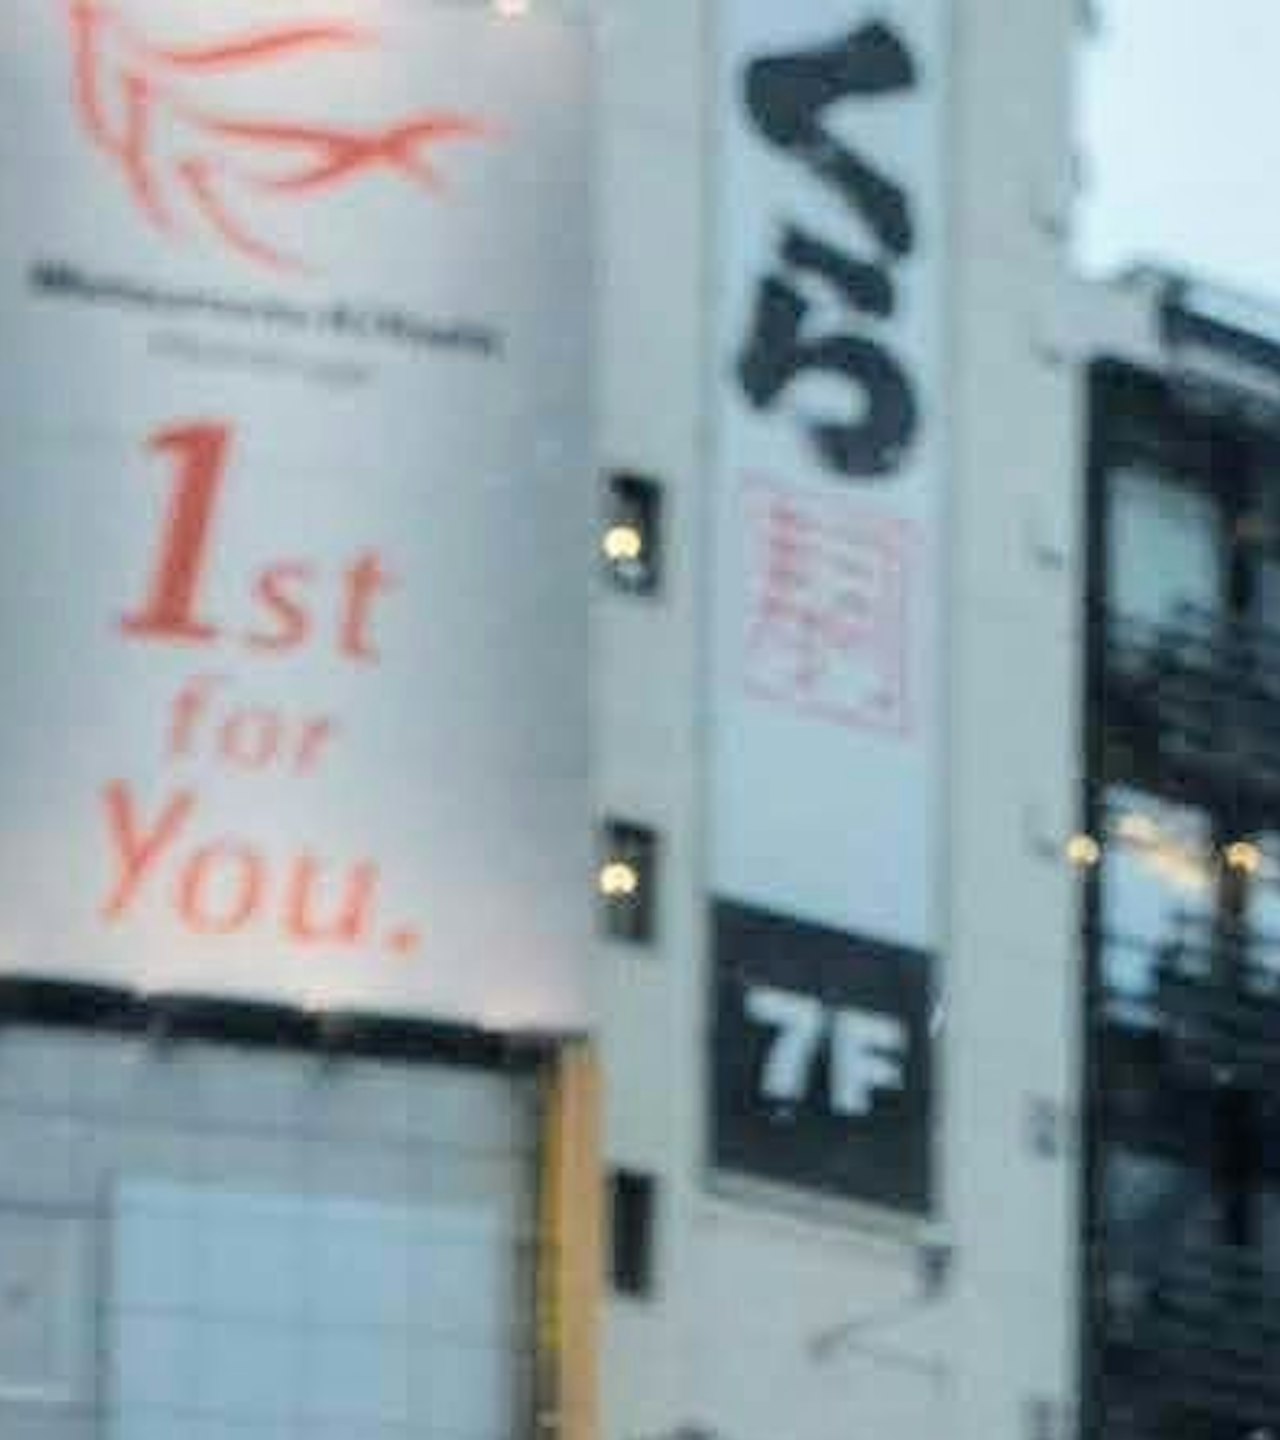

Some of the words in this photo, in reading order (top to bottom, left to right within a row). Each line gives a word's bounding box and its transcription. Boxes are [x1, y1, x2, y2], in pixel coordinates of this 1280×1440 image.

[737, 17, 917, 477] くら
[109, 417, 400, 666] 1st
[166, 674, 340, 778] for
[99, 777, 422, 955] You.
[741, 985, 907, 1120] 7F
